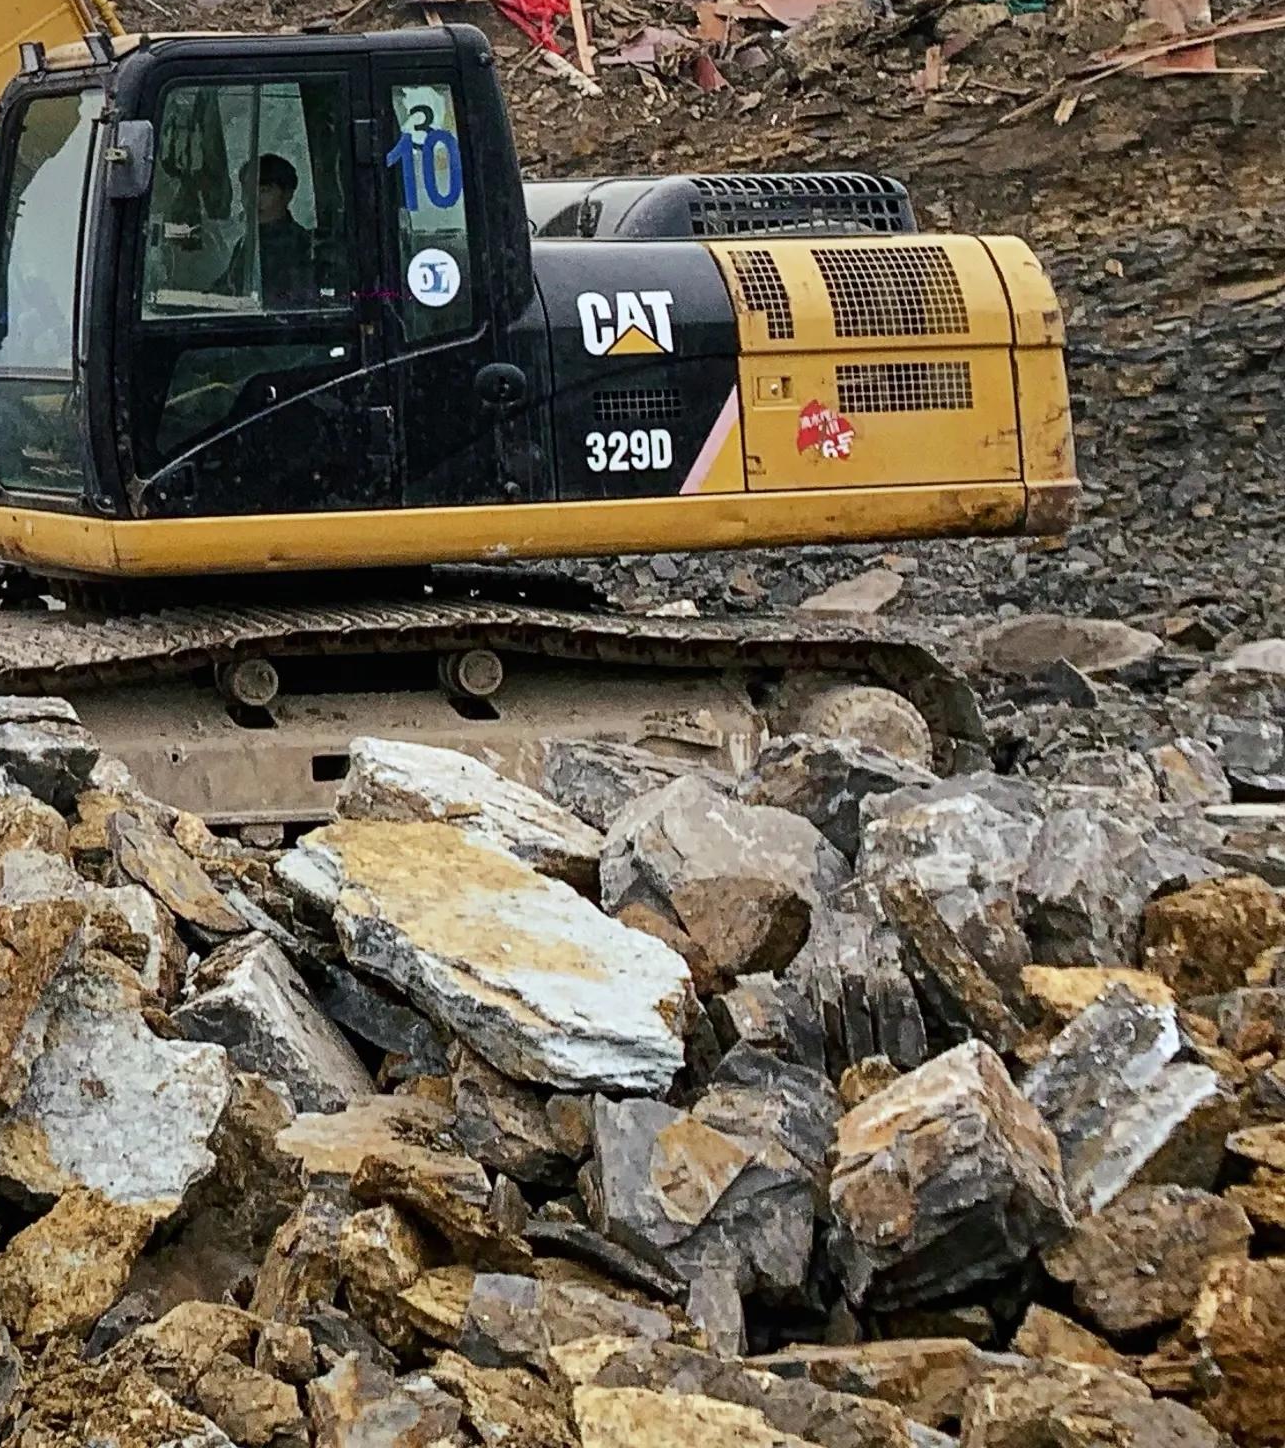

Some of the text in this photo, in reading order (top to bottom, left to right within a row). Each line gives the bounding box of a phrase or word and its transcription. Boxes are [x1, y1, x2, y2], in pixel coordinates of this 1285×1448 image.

[386, 129, 463, 212] 10
[577, 290, 674, 356] CAT
[585, 428, 673, 472] 329D
